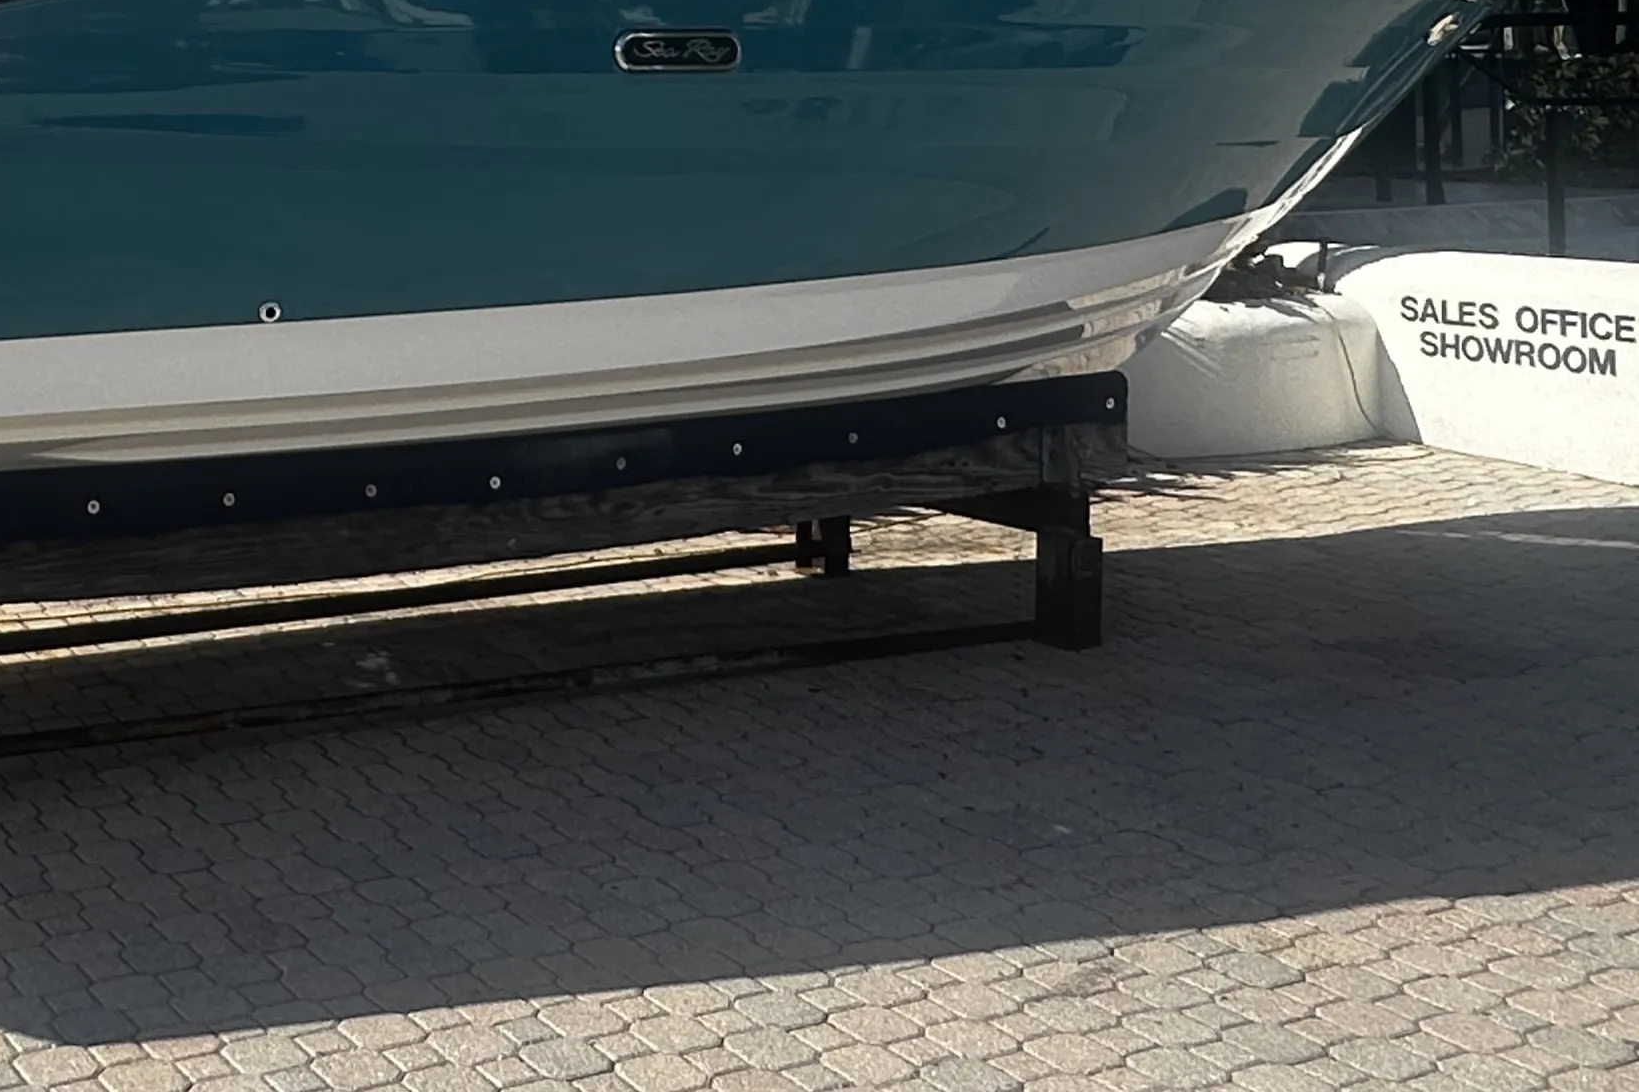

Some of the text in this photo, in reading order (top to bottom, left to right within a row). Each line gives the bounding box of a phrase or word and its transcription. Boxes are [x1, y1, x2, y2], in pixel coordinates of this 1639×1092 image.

[633, 38, 731, 63] Sea Ray
[1400, 295, 1637, 344] SALES OFFICE
[1420, 331, 1617, 377] SHOWROOM
